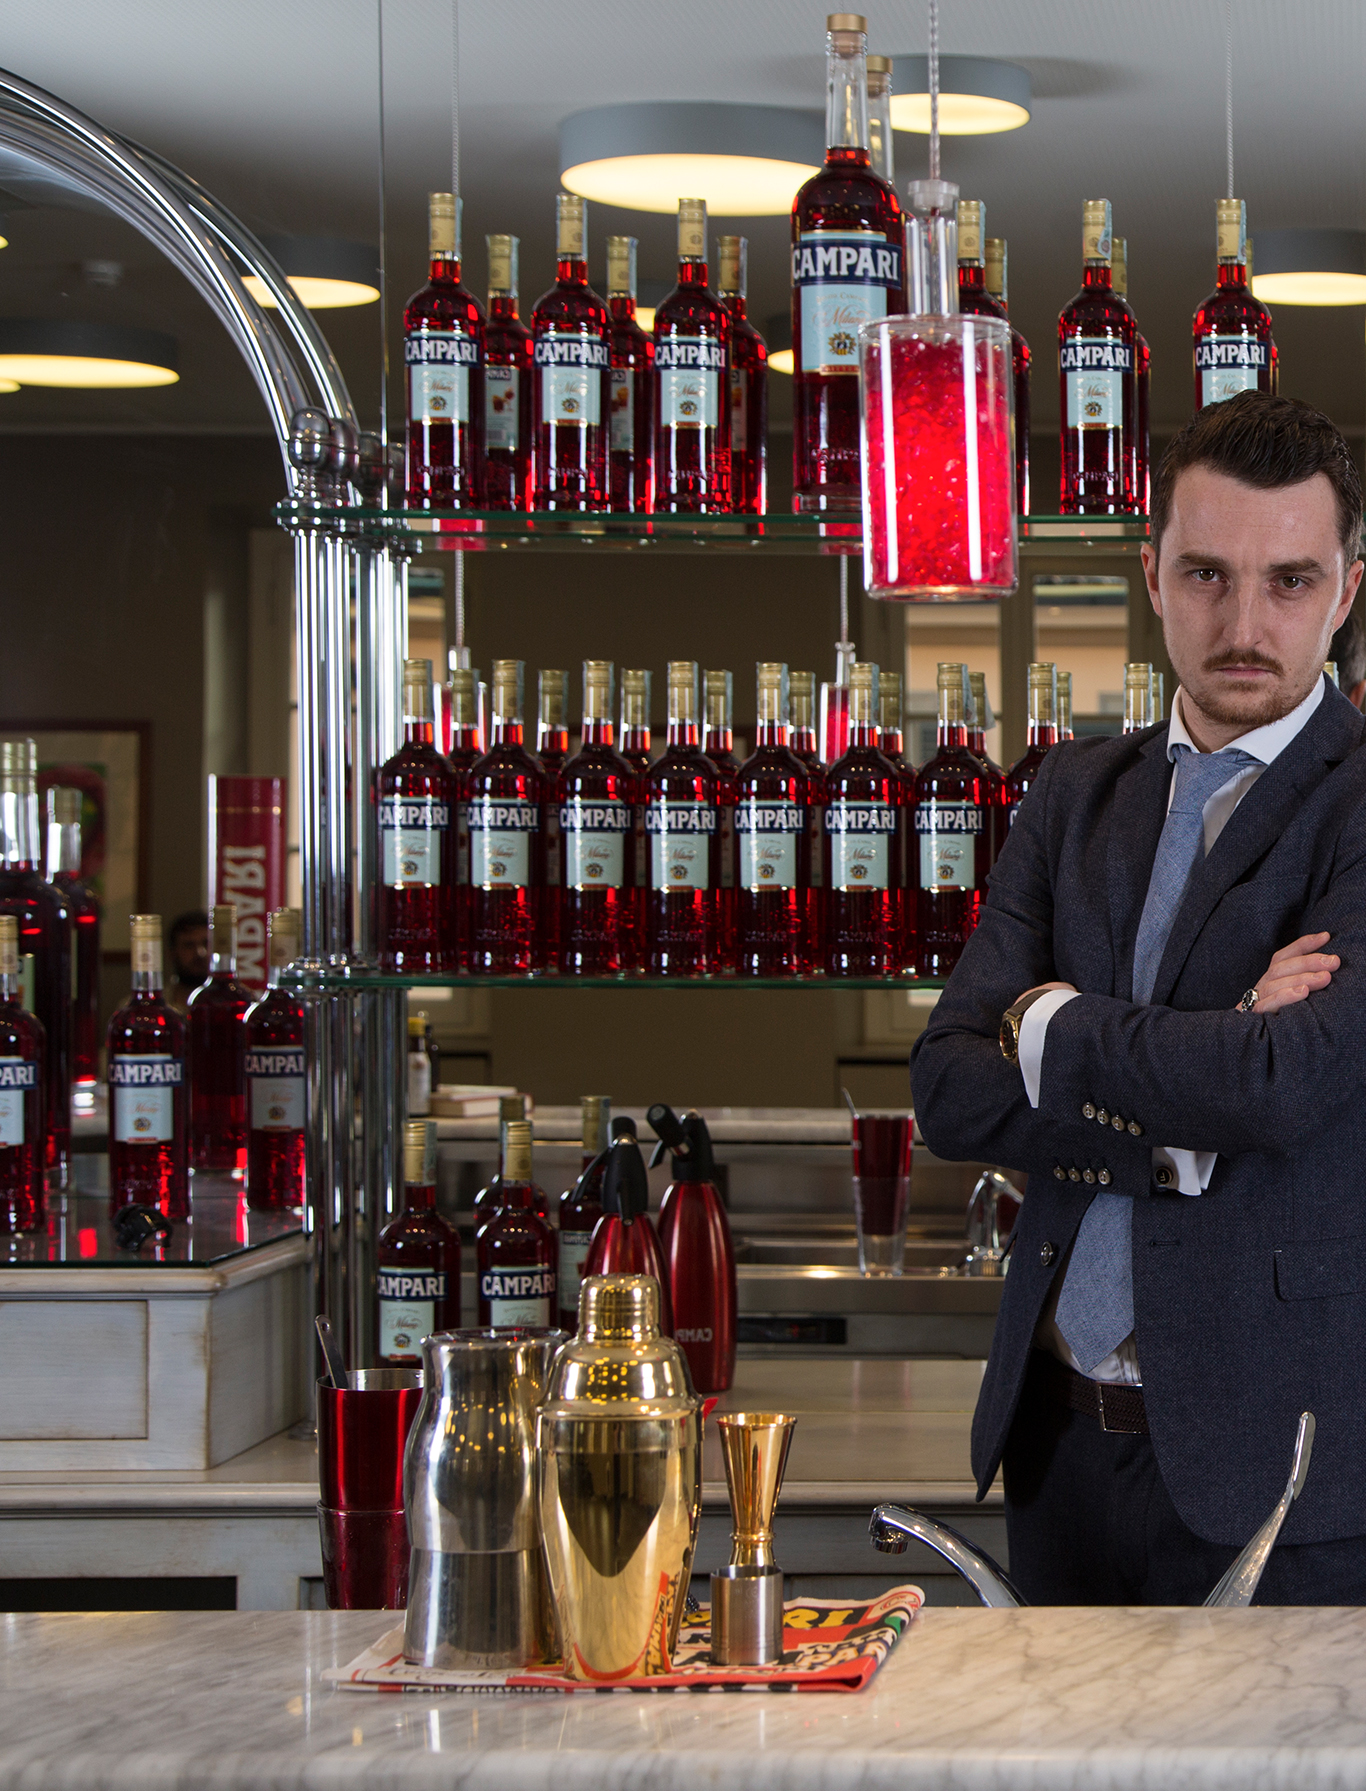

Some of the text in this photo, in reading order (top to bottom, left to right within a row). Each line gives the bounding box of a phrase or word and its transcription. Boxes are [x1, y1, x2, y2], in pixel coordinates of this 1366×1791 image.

[793, 246, 898, 280] CAMPARI
[405, 340, 477, 362] CAMPARI
[534, 342, 608, 365] CAMPARI
[654, 345, 726, 367] CAMPARI
[1060, 346, 1130, 367] CAMPARI
[1196, 344, 1265, 365] CAMPARI
[378, 805, 448, 826] CAMPARI
[467, 807, 538, 827] CAMPARI
[560, 808, 631, 828] CAMPARI
[645, 810, 716, 830] CAMPARI
[734, 809, 803, 829] CAMPARI
[825, 809, 895, 829] CAMPARI
[915, 810, 983, 830] CAMPARI
[108, 1062, 182, 1084] CAMPARI
